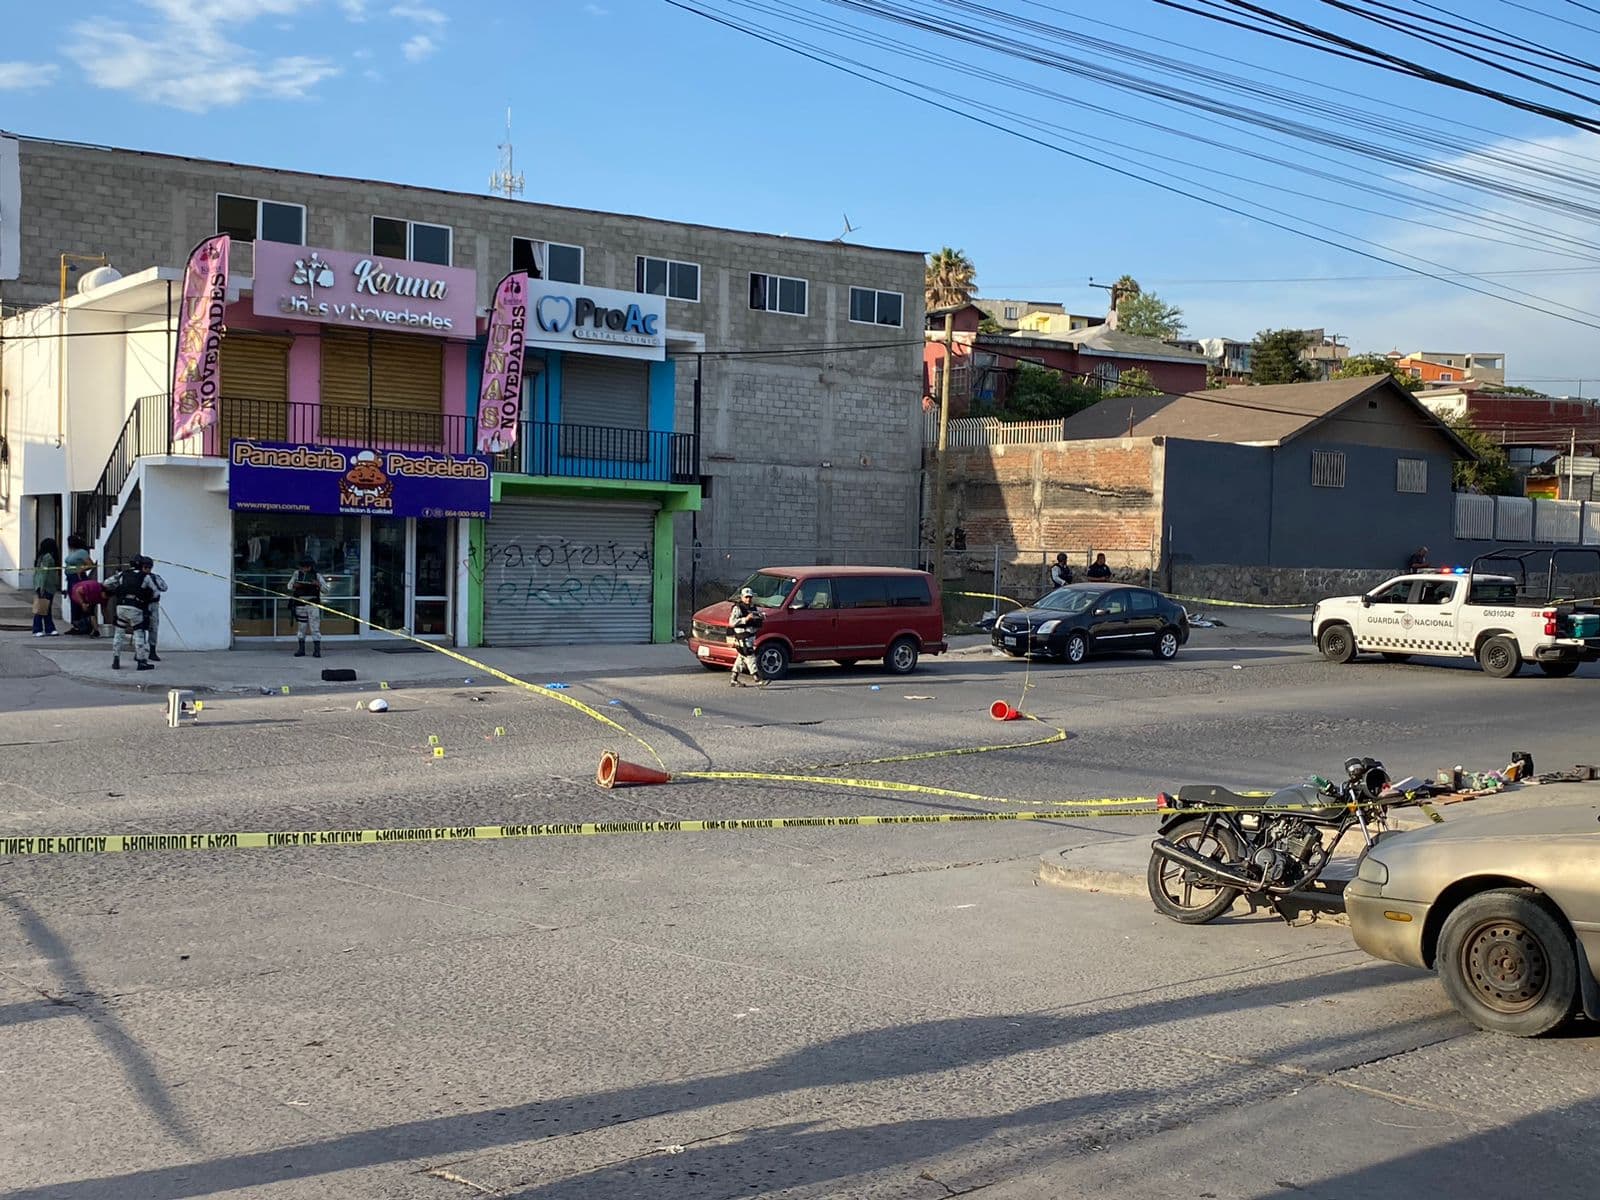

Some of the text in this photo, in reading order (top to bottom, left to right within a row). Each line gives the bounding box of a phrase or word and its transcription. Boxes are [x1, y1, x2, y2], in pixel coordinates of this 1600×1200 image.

[333, 303, 347, 321] y
[350, 303, 453, 330] Novedades
[575, 297, 658, 336] ProAc
[200, 273, 226, 411] NOVEDADES
[577, 330, 658, 345] DENTAL CLINIC
[501, 305, 526, 429] NOVEDADES
[1367, 616, 1454, 628] GUARDIA NACIONAL
